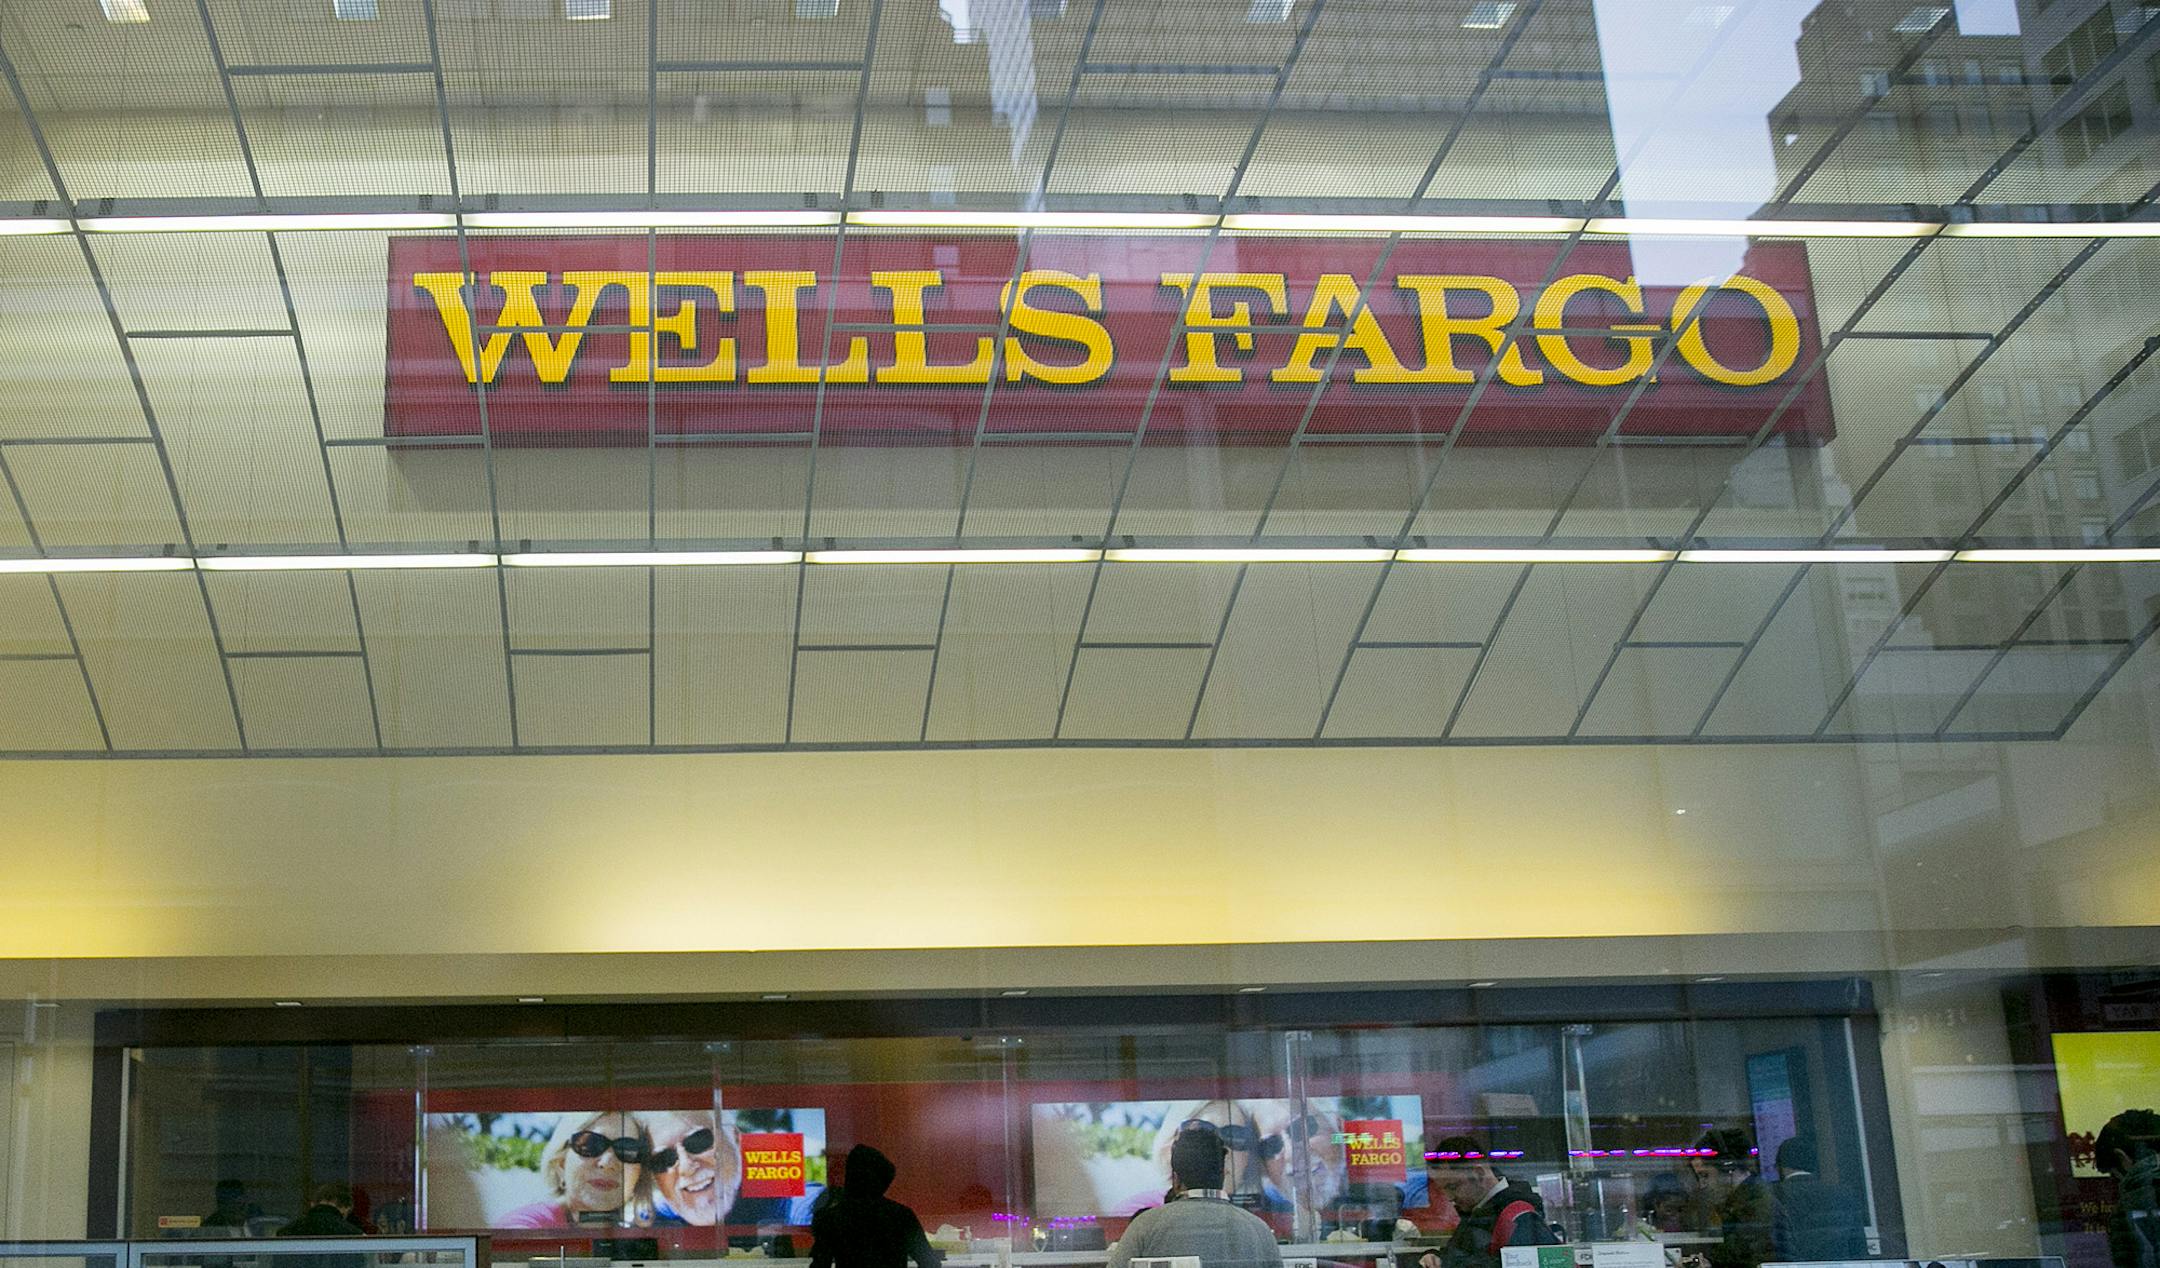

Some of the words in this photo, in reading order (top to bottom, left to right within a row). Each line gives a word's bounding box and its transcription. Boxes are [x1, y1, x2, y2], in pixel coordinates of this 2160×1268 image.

[413, 269, 1114, 385] WELLS
[1162, 273, 1800, 387] FARGO
[745, 1150, 802, 1164] WELLS
[1351, 1152, 1402, 1166] FARGO
[746, 1166, 802, 1180] FARGO
